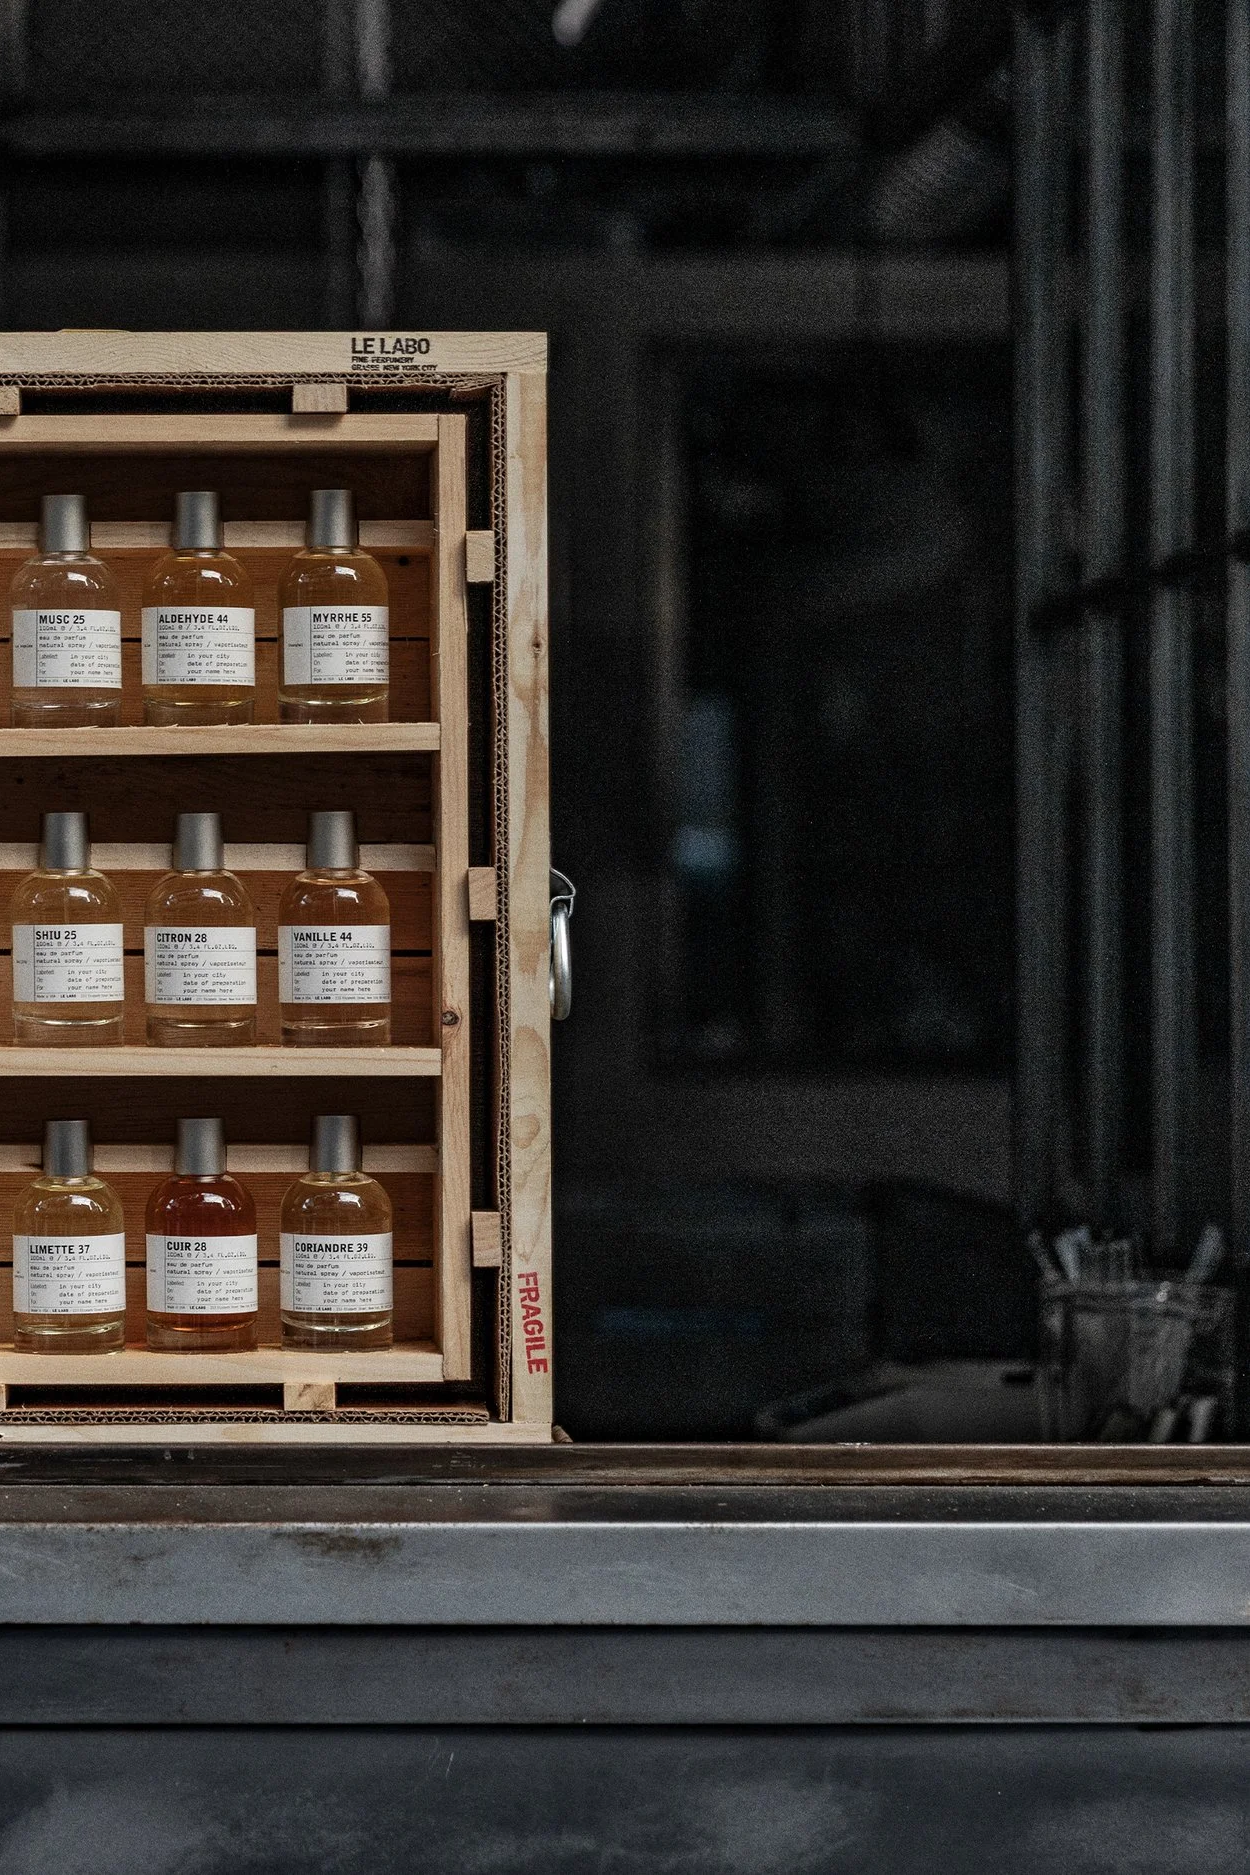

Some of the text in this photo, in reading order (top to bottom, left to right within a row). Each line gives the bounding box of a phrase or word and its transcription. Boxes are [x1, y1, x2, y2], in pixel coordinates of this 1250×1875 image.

[352, 338, 430, 354] LE LABO
[39, 615, 85, 624] MUSC 25
[159, 615, 228, 623] ALDEHYDE 44
[313, 613, 371, 622] MYRRHE 55
[36, 931, 76, 939] SHIU 25
[157, 933, 207, 942] CITRON 28
[294, 933, 352, 941] VANILLE 44
[30, 1245, 90, 1254] LIMETTE 37
[167, 1242, 206, 1251] CUIR 28
[296, 1243, 368, 1252] CORIANDRE 39
[517, 1271, 548, 1374] FRAGILE
